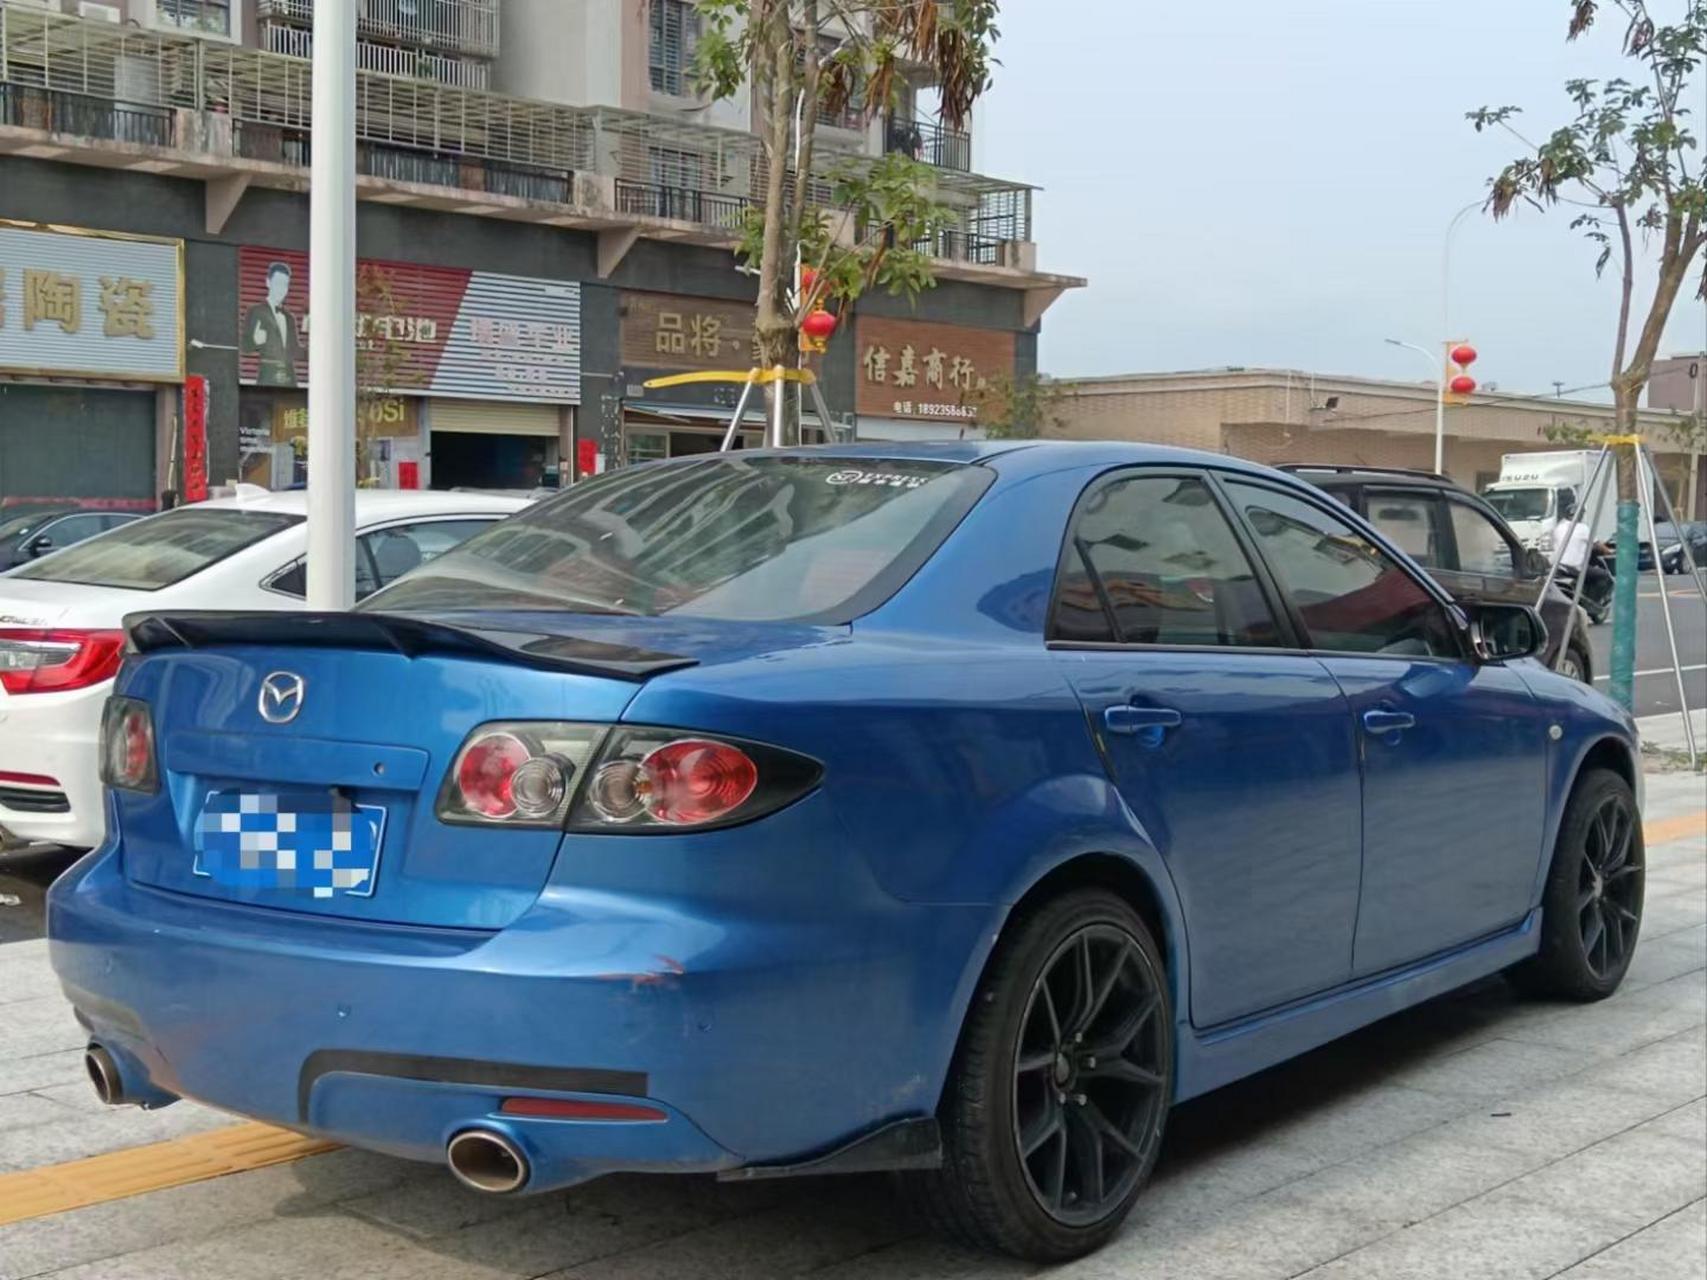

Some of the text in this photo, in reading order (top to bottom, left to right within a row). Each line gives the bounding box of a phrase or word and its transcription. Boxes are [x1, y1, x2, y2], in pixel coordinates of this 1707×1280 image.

[0, 267, 155, 340] 陶瓷
[862, 343, 975, 391] 信嘉商行
